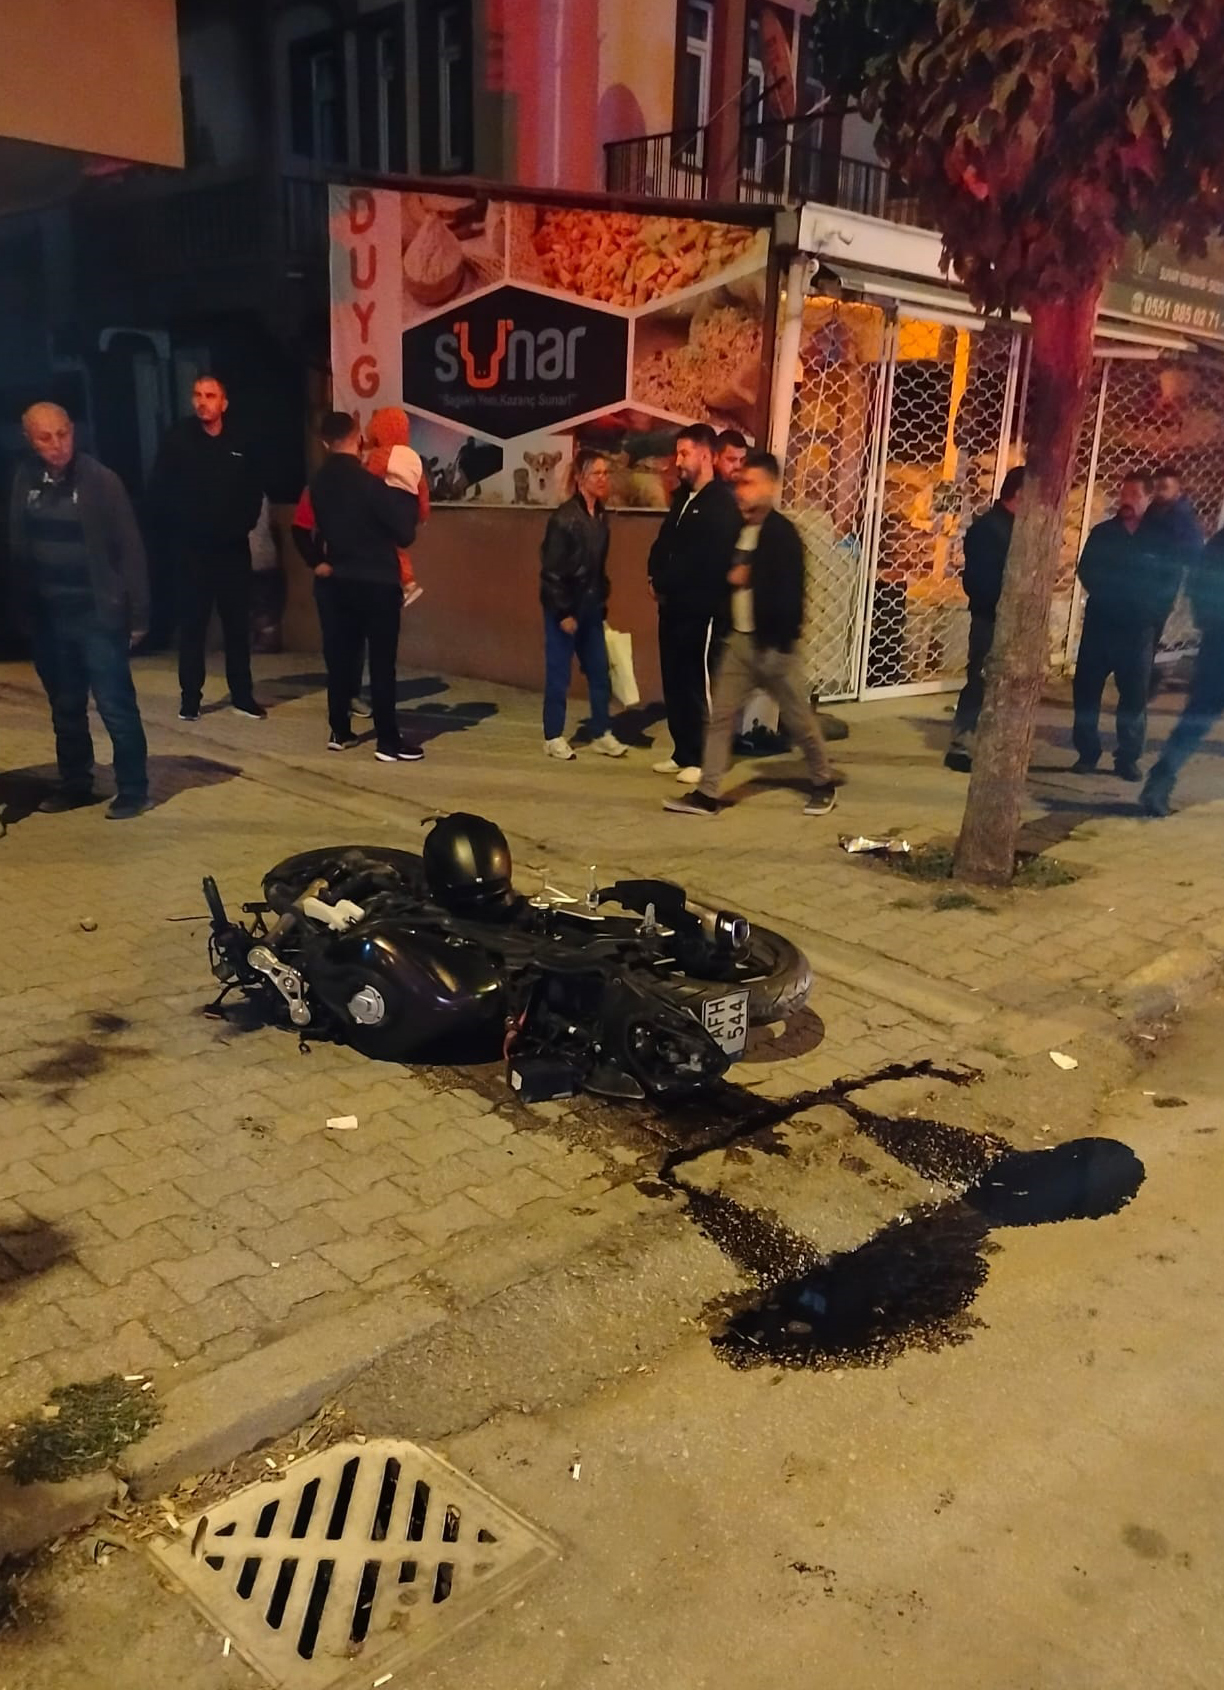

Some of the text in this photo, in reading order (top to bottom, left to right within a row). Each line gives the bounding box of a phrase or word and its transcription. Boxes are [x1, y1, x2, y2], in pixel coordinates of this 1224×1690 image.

[1144, 295, 1171, 320] 0551
[1193, 307, 1207, 326] 02
[707, 999, 745, 1040] AFH 544
